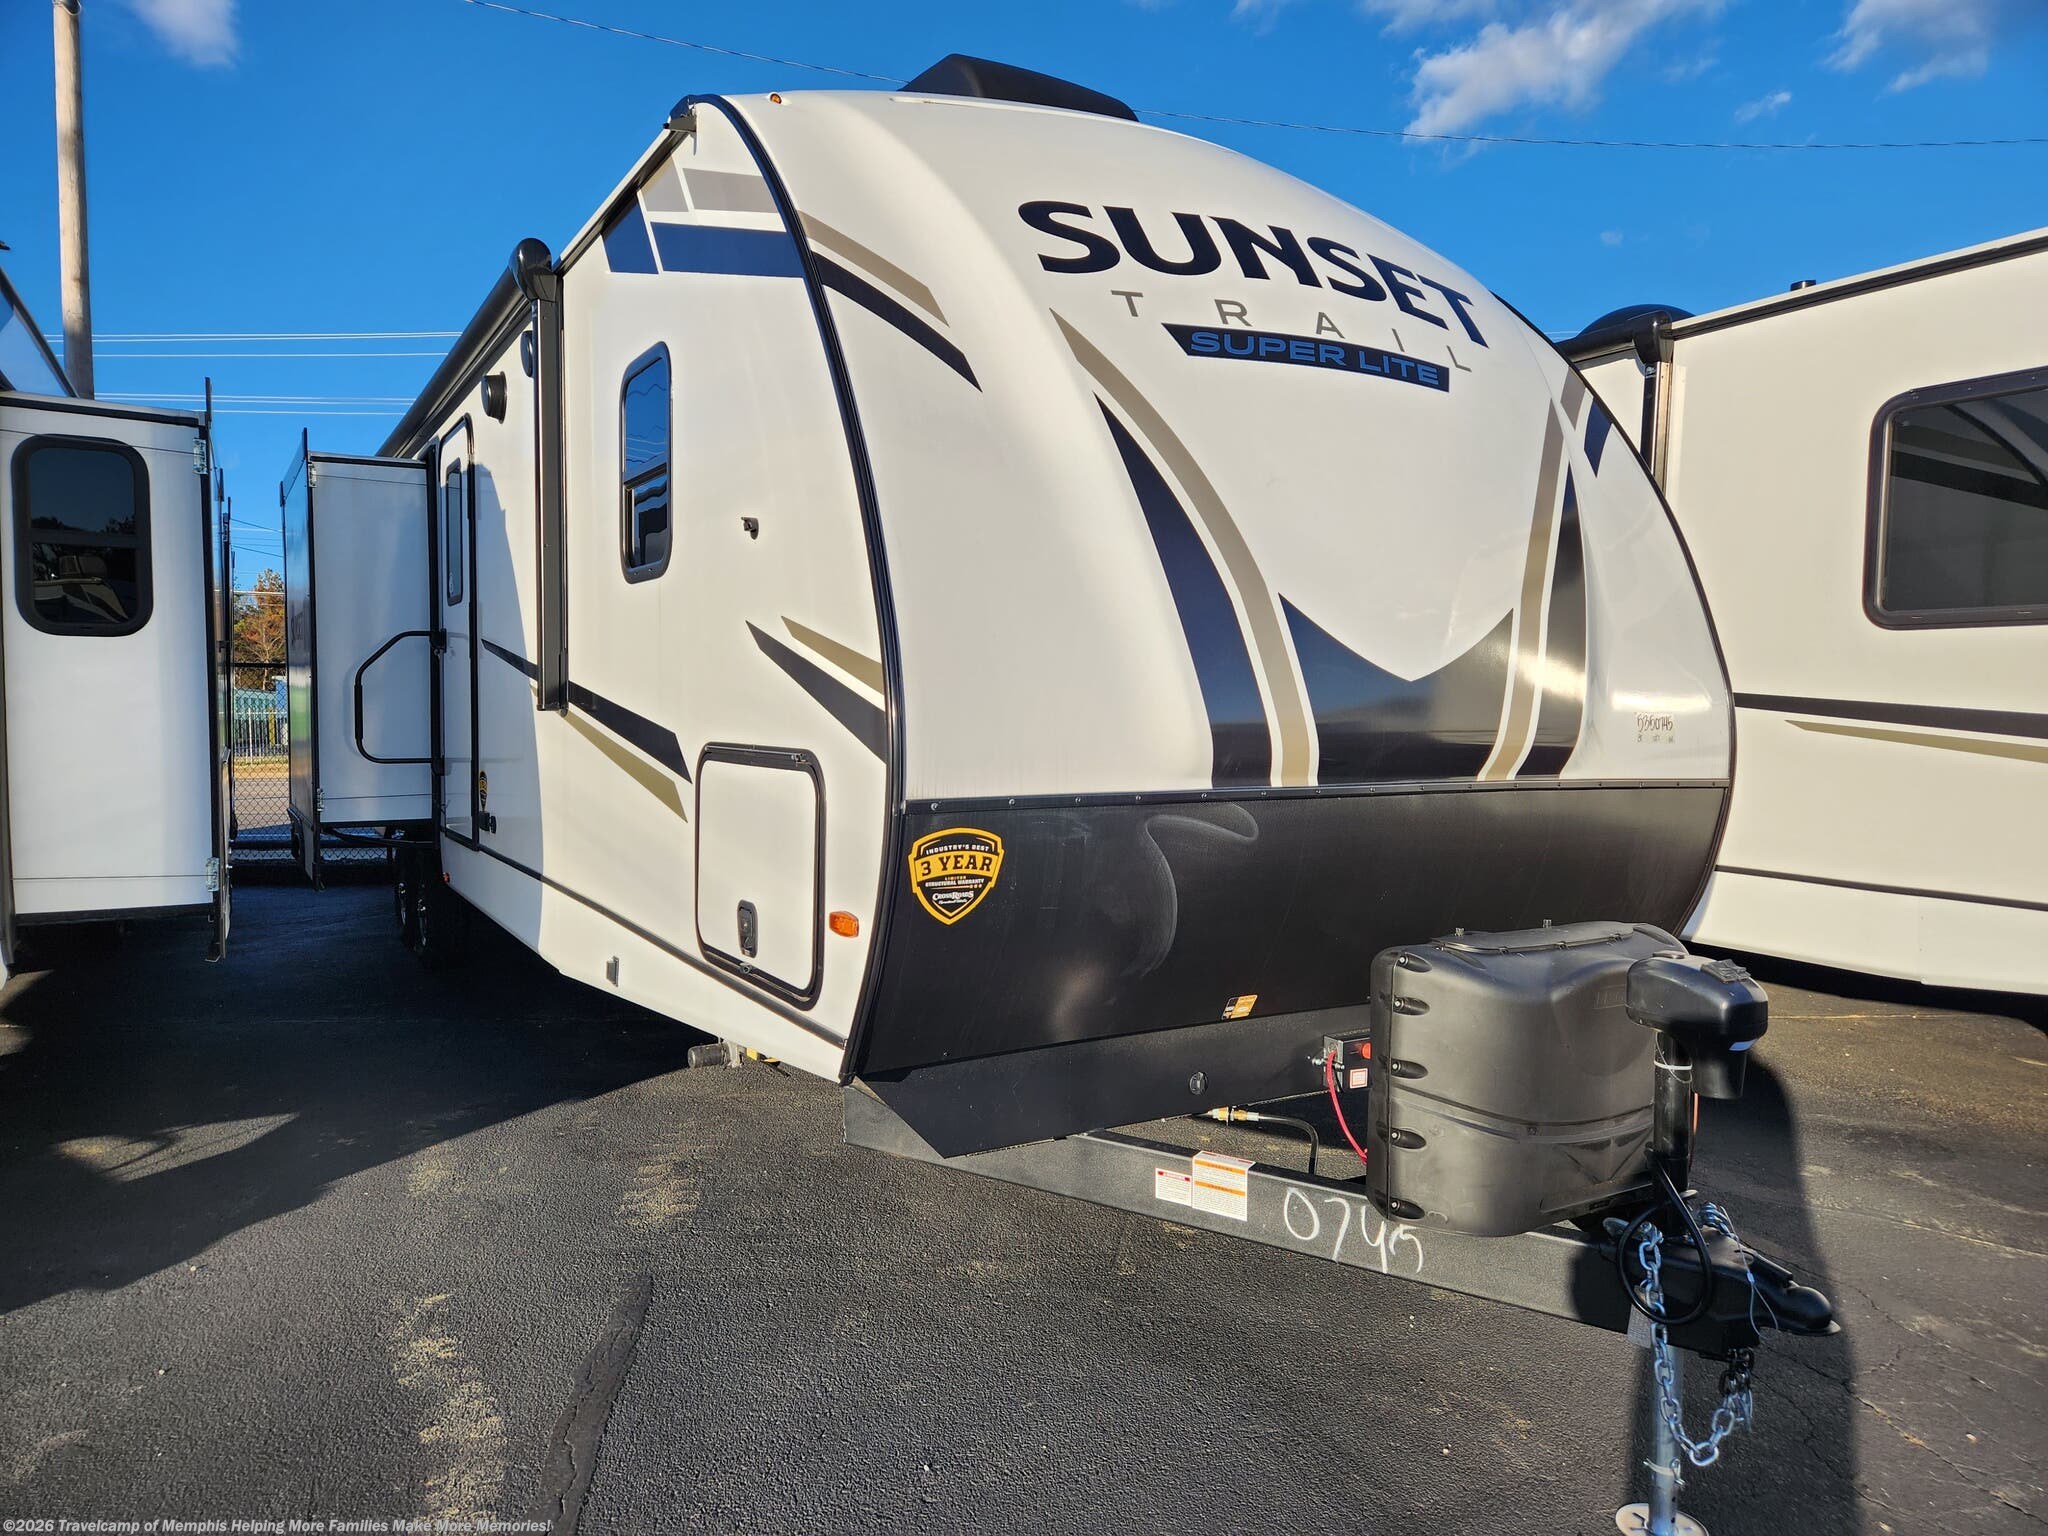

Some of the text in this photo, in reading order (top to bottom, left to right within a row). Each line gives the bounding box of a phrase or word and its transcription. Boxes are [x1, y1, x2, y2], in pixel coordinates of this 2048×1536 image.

[1018, 200, 1489, 348] SUNSET
[1111, 290, 1471, 372] TRAIL
[1190, 332, 1439, 385] SUPER LITE
[921, 855, 993, 876] 3 YEAR
[926, 844, 989, 855] INDUSTRY'S BEST
[1283, 1187, 1424, 1274] 0745
